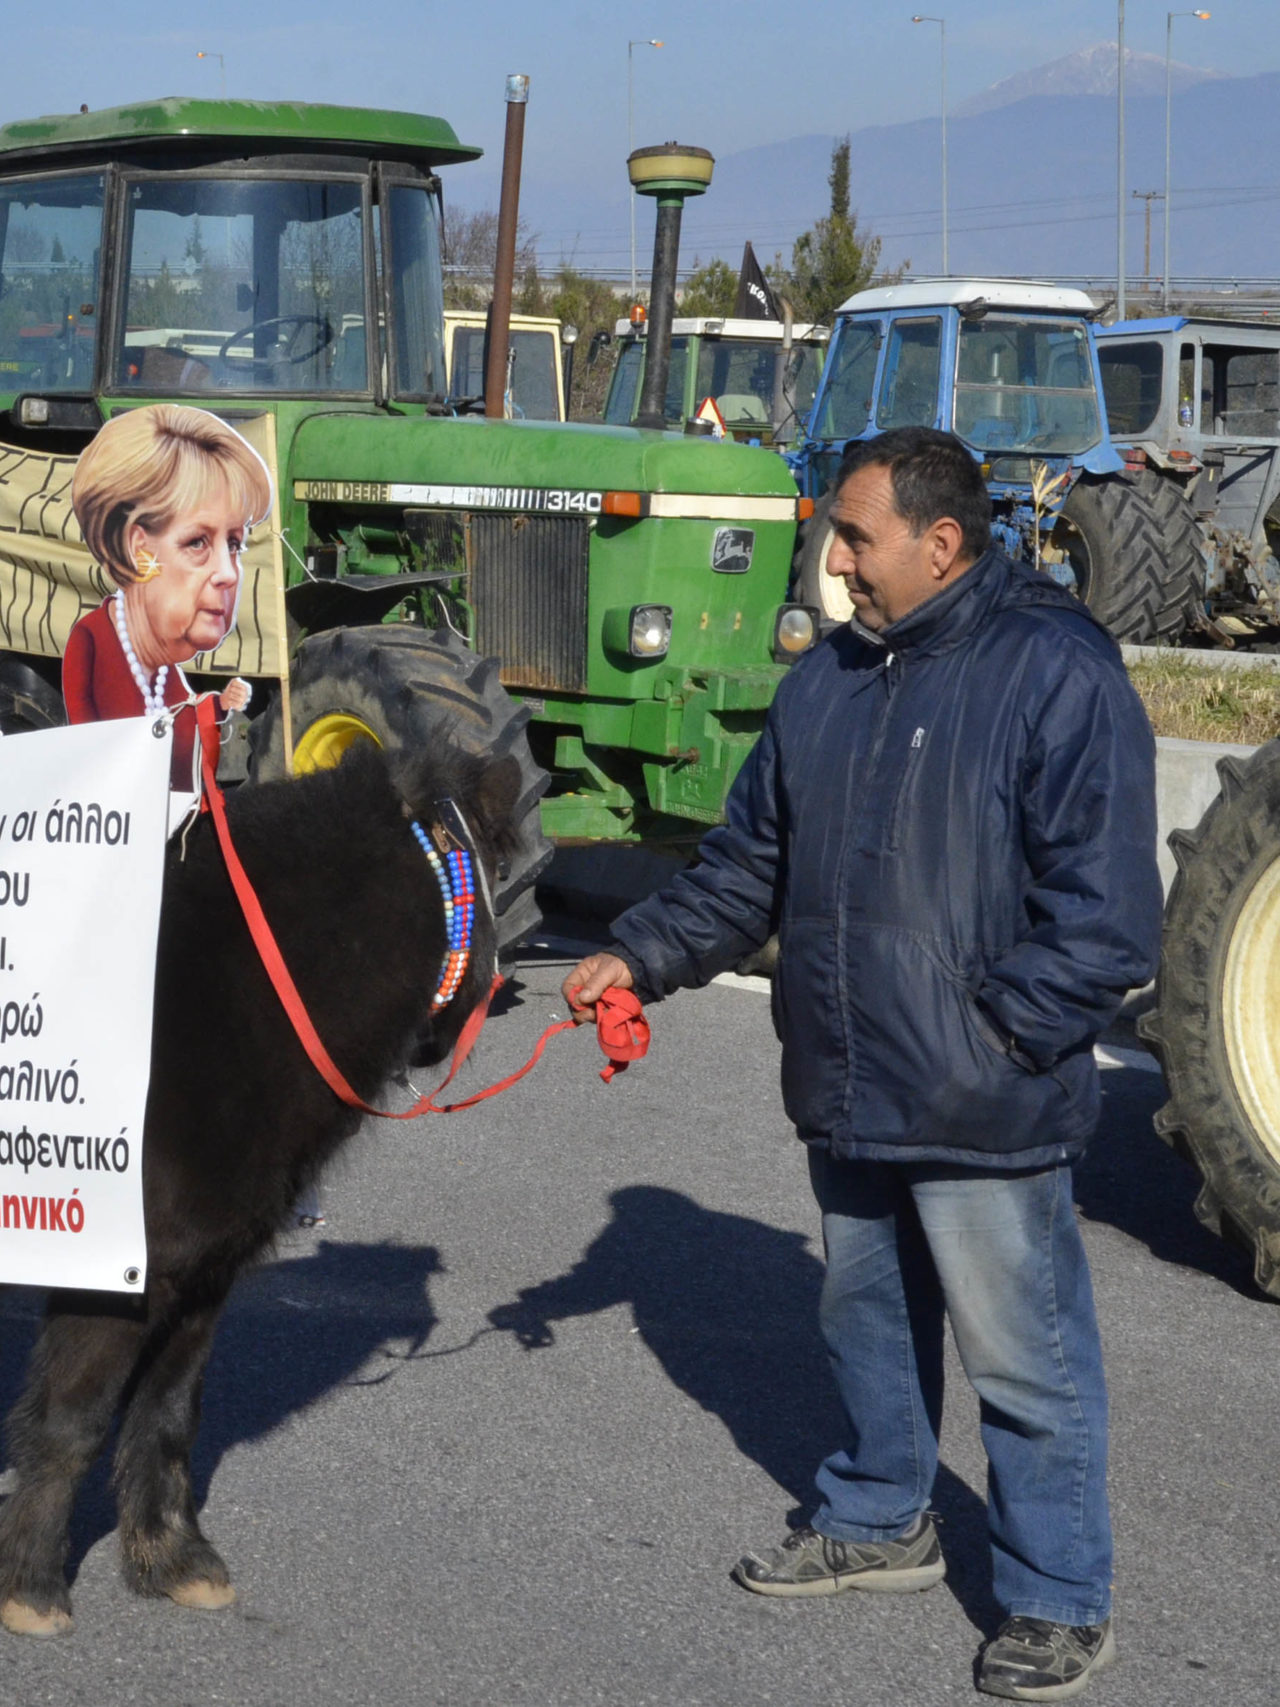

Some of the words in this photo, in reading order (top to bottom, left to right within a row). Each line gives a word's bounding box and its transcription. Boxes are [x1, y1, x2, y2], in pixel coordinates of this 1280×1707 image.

[304, 482, 338, 500] JOHN
[342, 483, 389, 501] DEERE
[546, 490, 604, 513] 3140
[10, 810, 37, 843] οι
[44, 798, 132, 847] άλλοι
